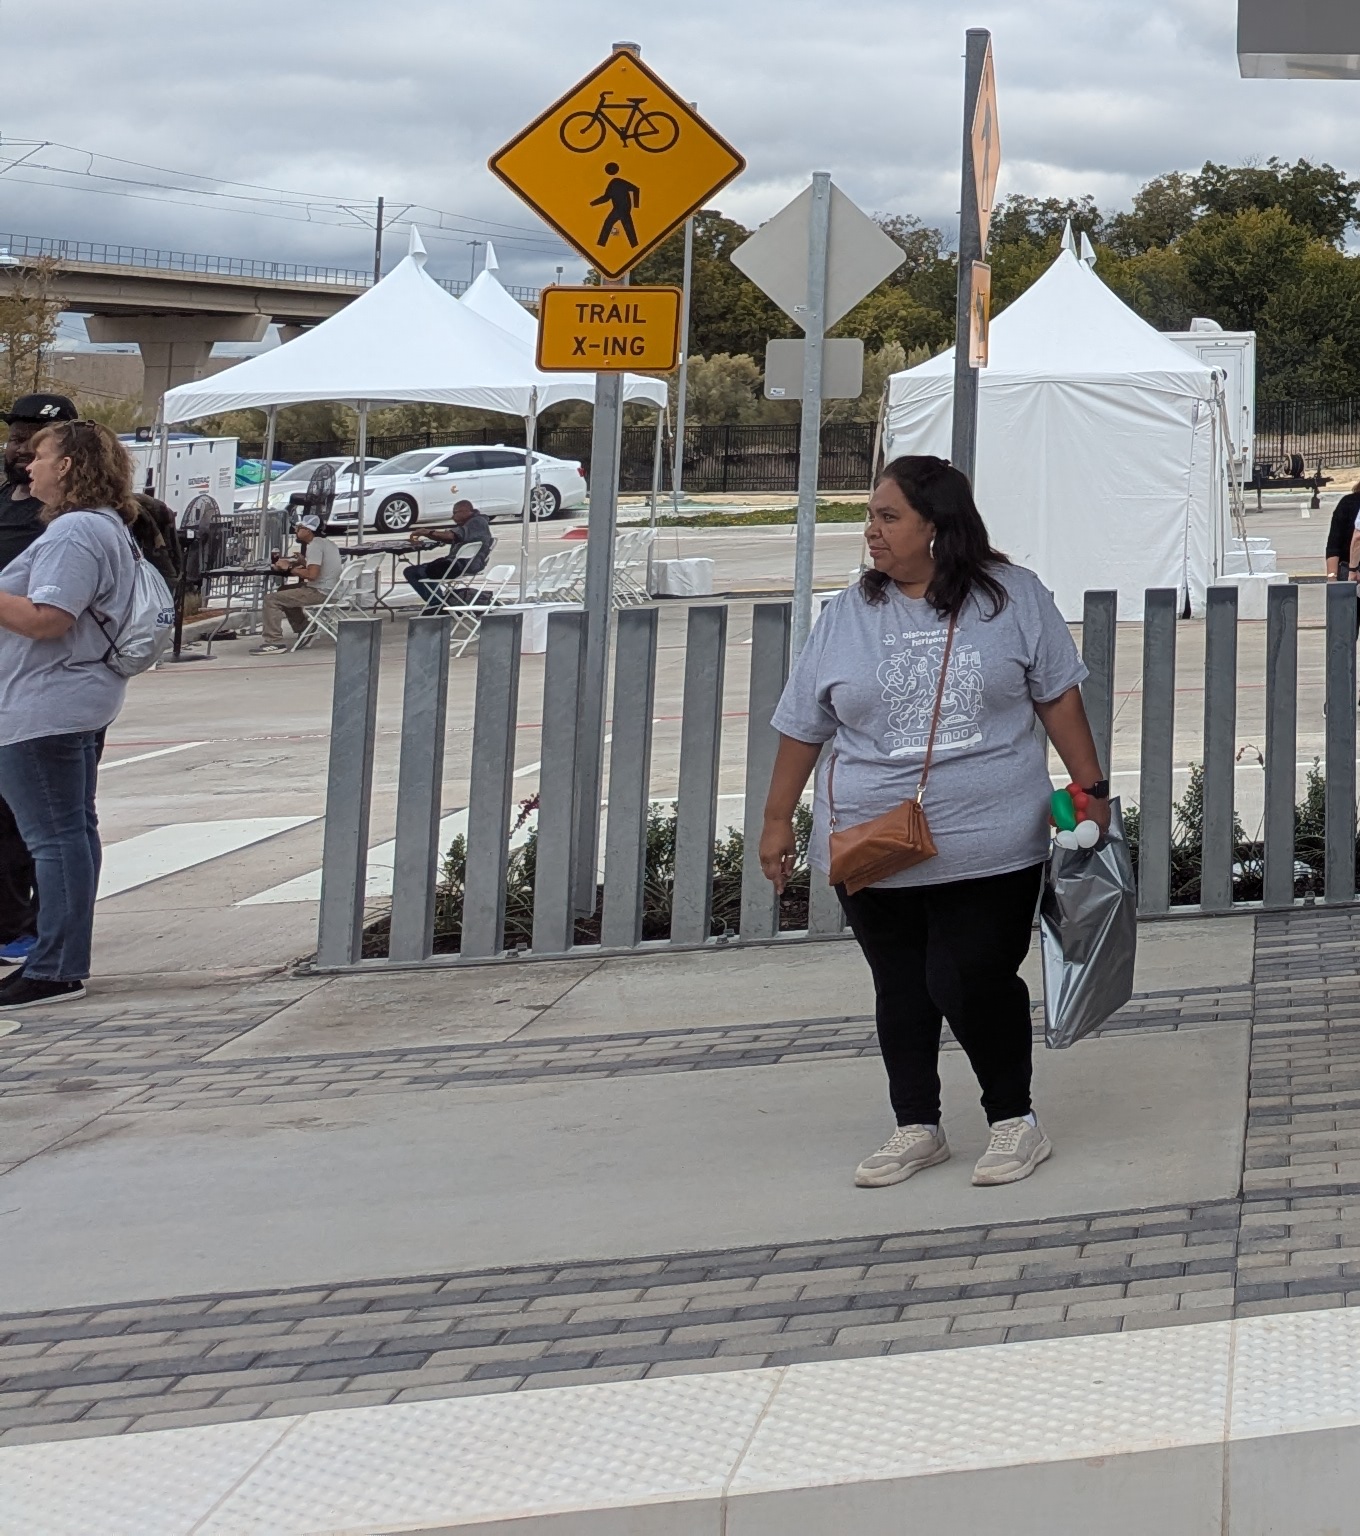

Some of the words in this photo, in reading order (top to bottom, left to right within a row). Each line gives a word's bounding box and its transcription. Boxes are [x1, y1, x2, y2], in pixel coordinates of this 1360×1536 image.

[575, 302, 647, 325] TRAIL
[572, 336, 646, 359] X-ING
[40, 404, 61, 418] 24
[943, 626, 961, 636] nw
